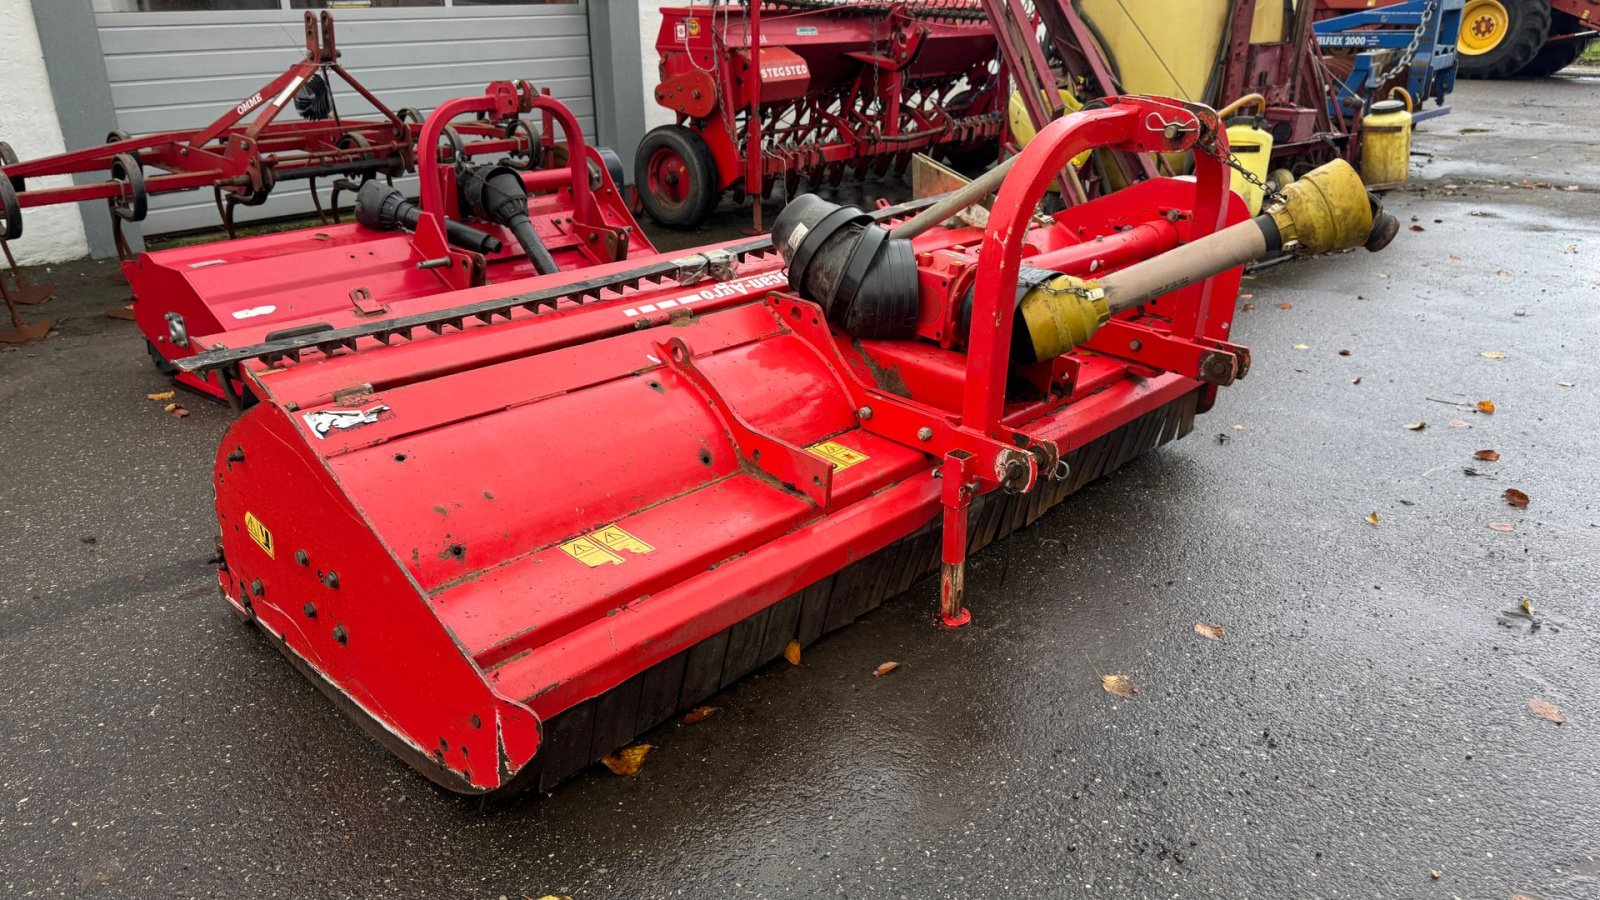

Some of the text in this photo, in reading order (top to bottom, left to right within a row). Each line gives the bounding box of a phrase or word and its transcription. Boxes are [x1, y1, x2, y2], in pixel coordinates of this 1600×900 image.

[1345, 36, 1366, 46] 2000
[760, 64, 808, 79] STEGSTED
[237, 92, 263, 115] OMME
